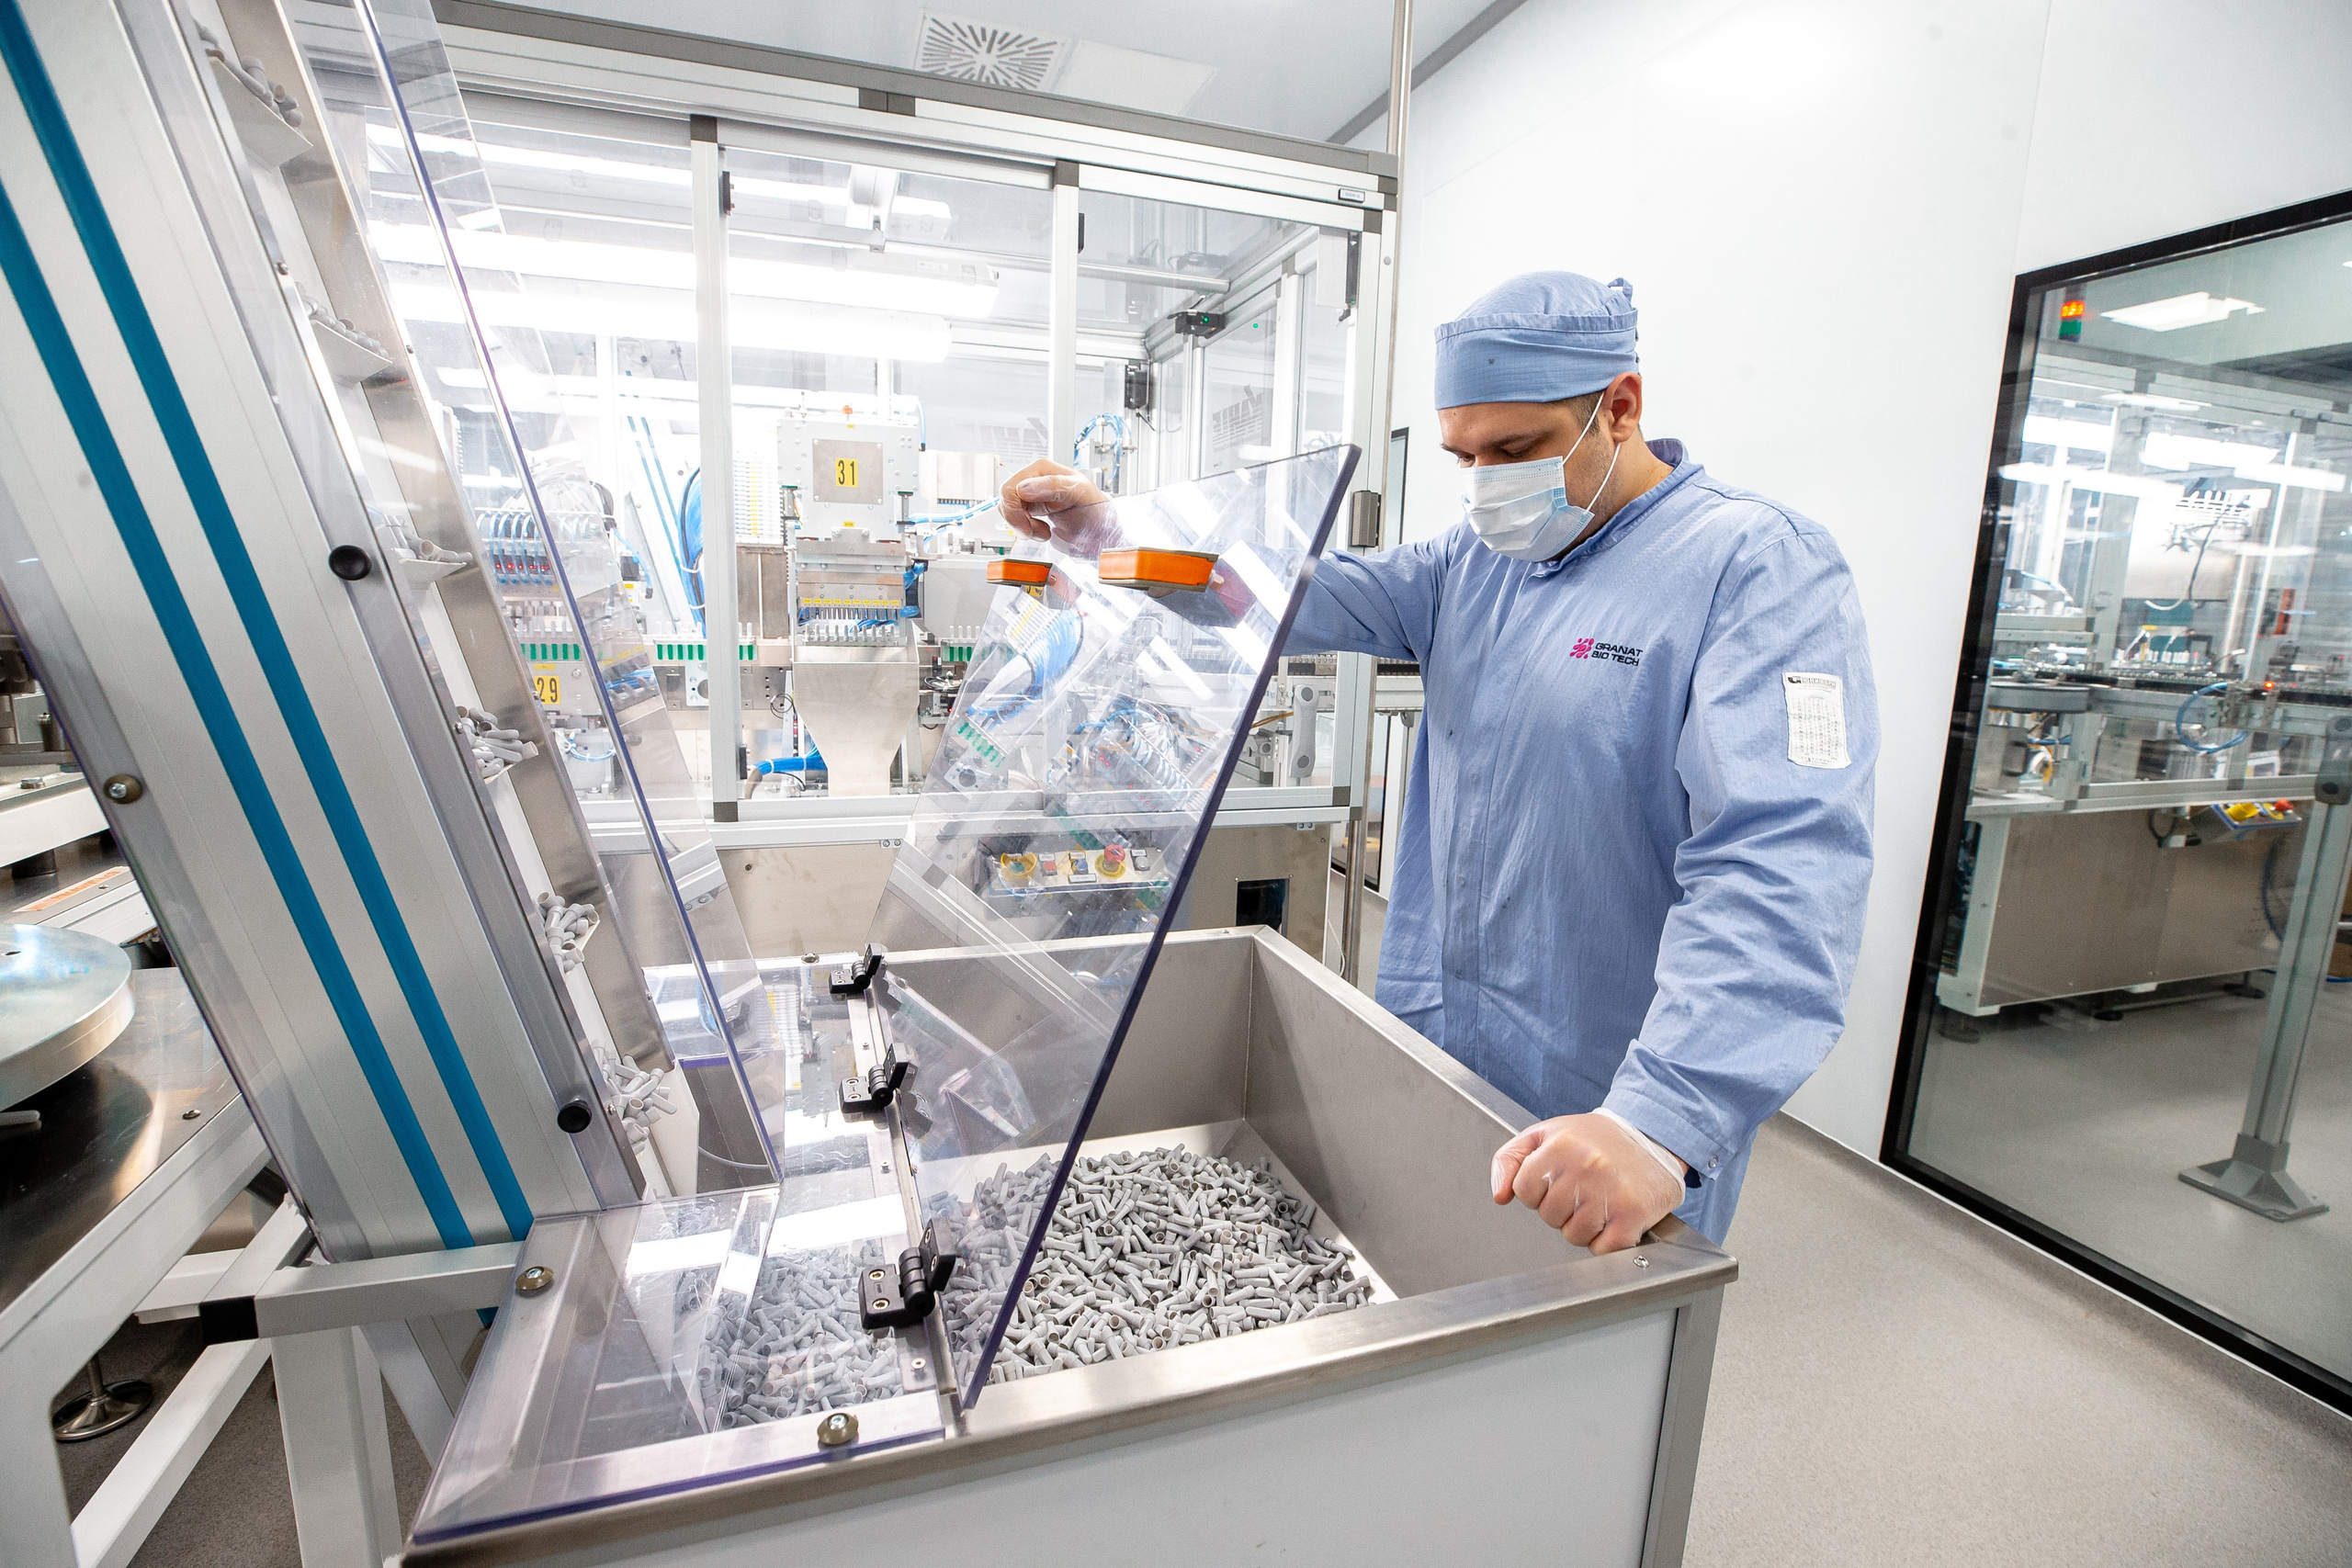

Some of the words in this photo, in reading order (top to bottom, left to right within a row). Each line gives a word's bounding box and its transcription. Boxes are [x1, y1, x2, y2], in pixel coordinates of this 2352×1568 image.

[838, 459, 855, 486] 31
[1591, 650, 1610, 660] BIO
[1611, 653, 1640, 667] TECH
[1595, 642, 1644, 657] GRANAT
[537, 677, 558, 703] 29
